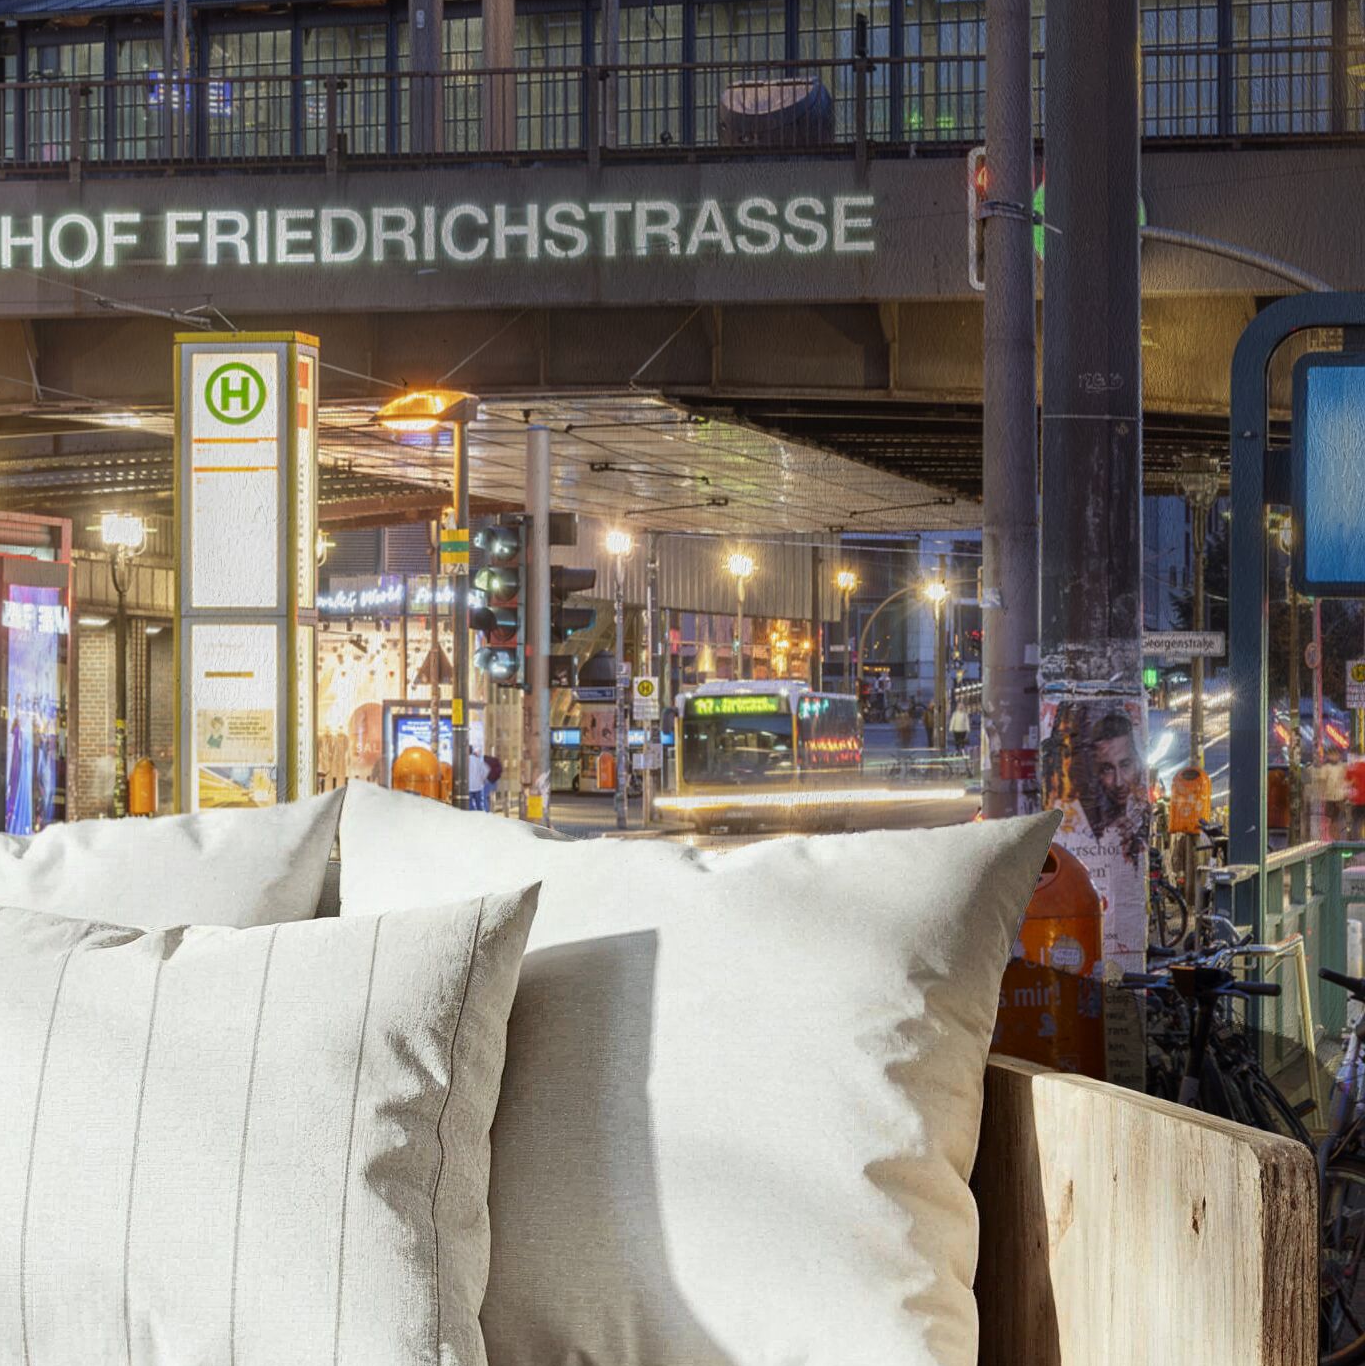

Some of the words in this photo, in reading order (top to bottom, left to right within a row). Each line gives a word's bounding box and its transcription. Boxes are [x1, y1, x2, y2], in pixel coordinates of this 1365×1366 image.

[165, 195, 875, 266] FRIEDRICHSTRASSE
[221, 377, 250, 411] H
[1014, 981, 1062, 1008] mir!
